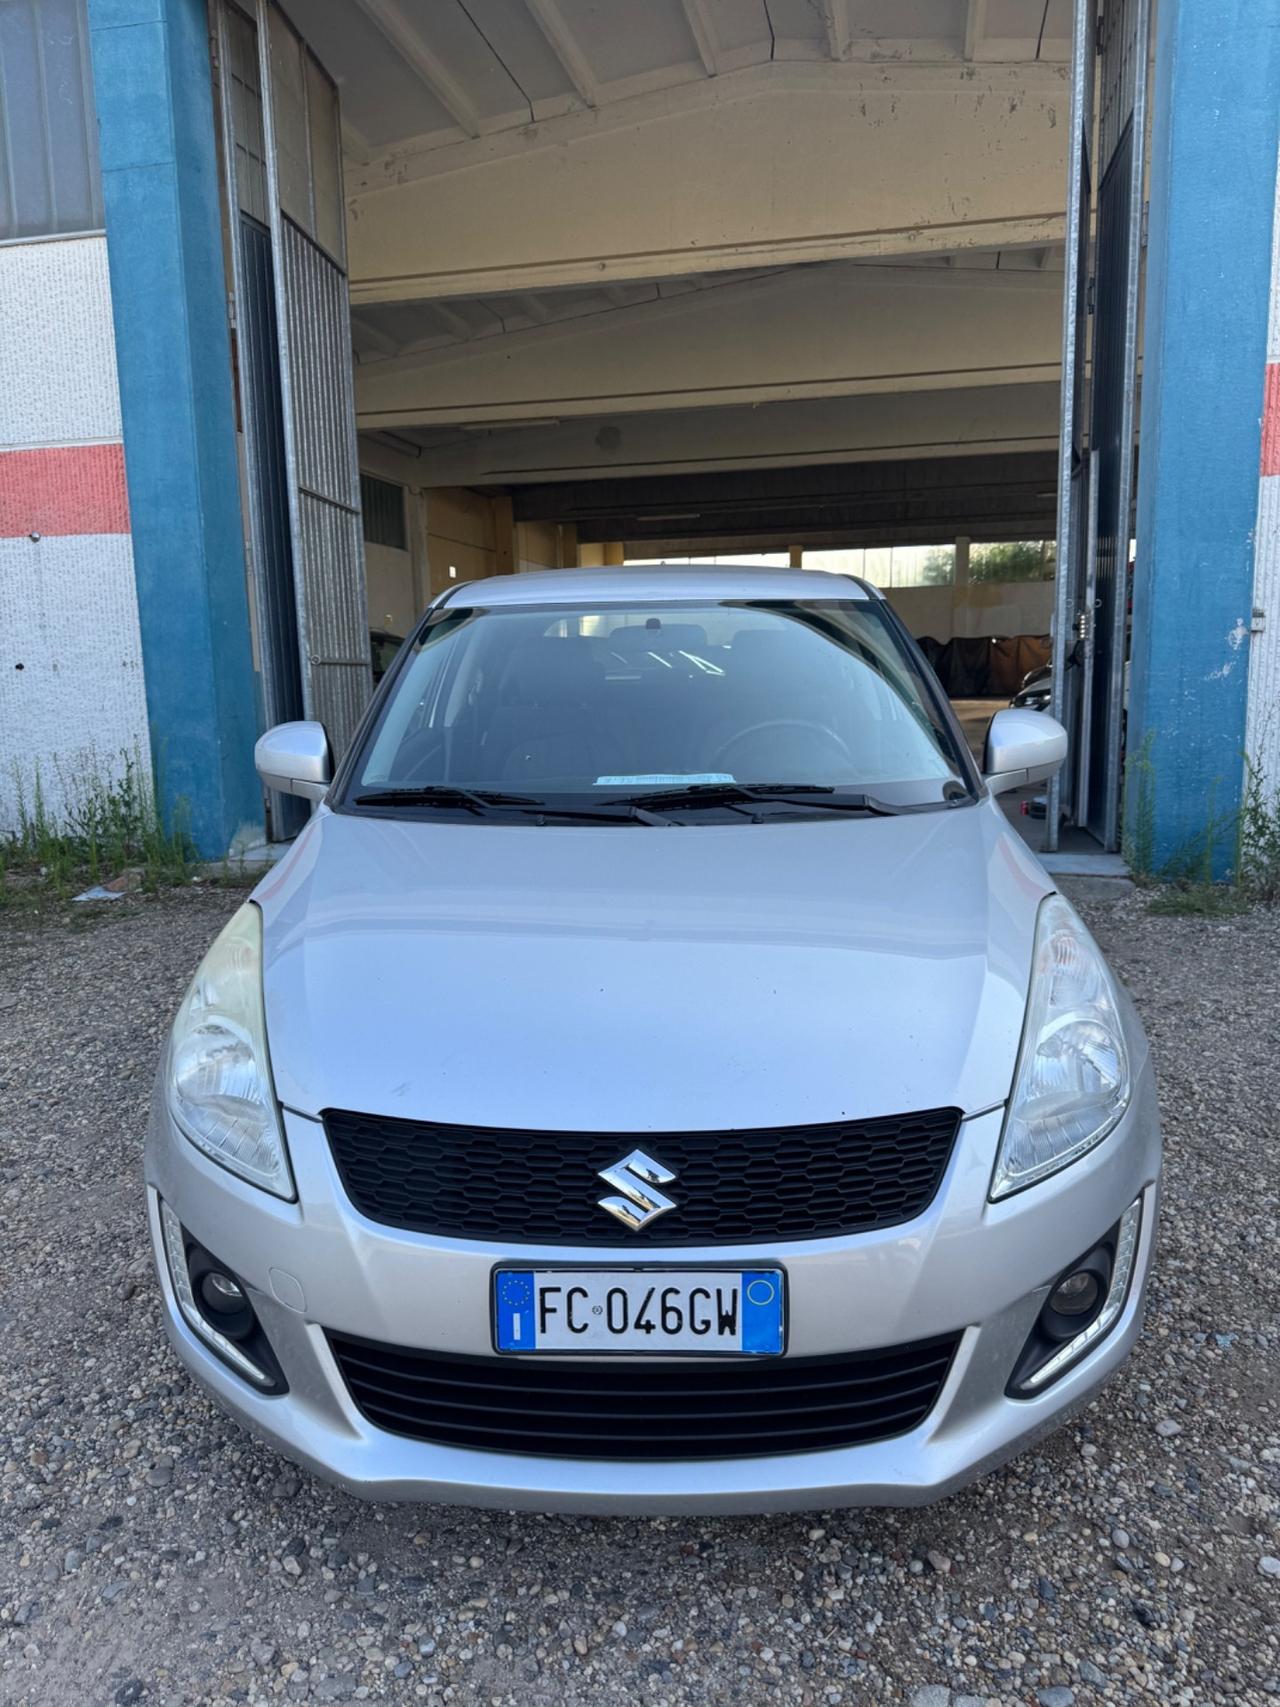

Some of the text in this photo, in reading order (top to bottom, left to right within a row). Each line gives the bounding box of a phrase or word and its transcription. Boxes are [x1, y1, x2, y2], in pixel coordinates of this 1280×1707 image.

[513, 1313, 520, 1340] I
[539, 1287, 738, 1335] FC 046GW
